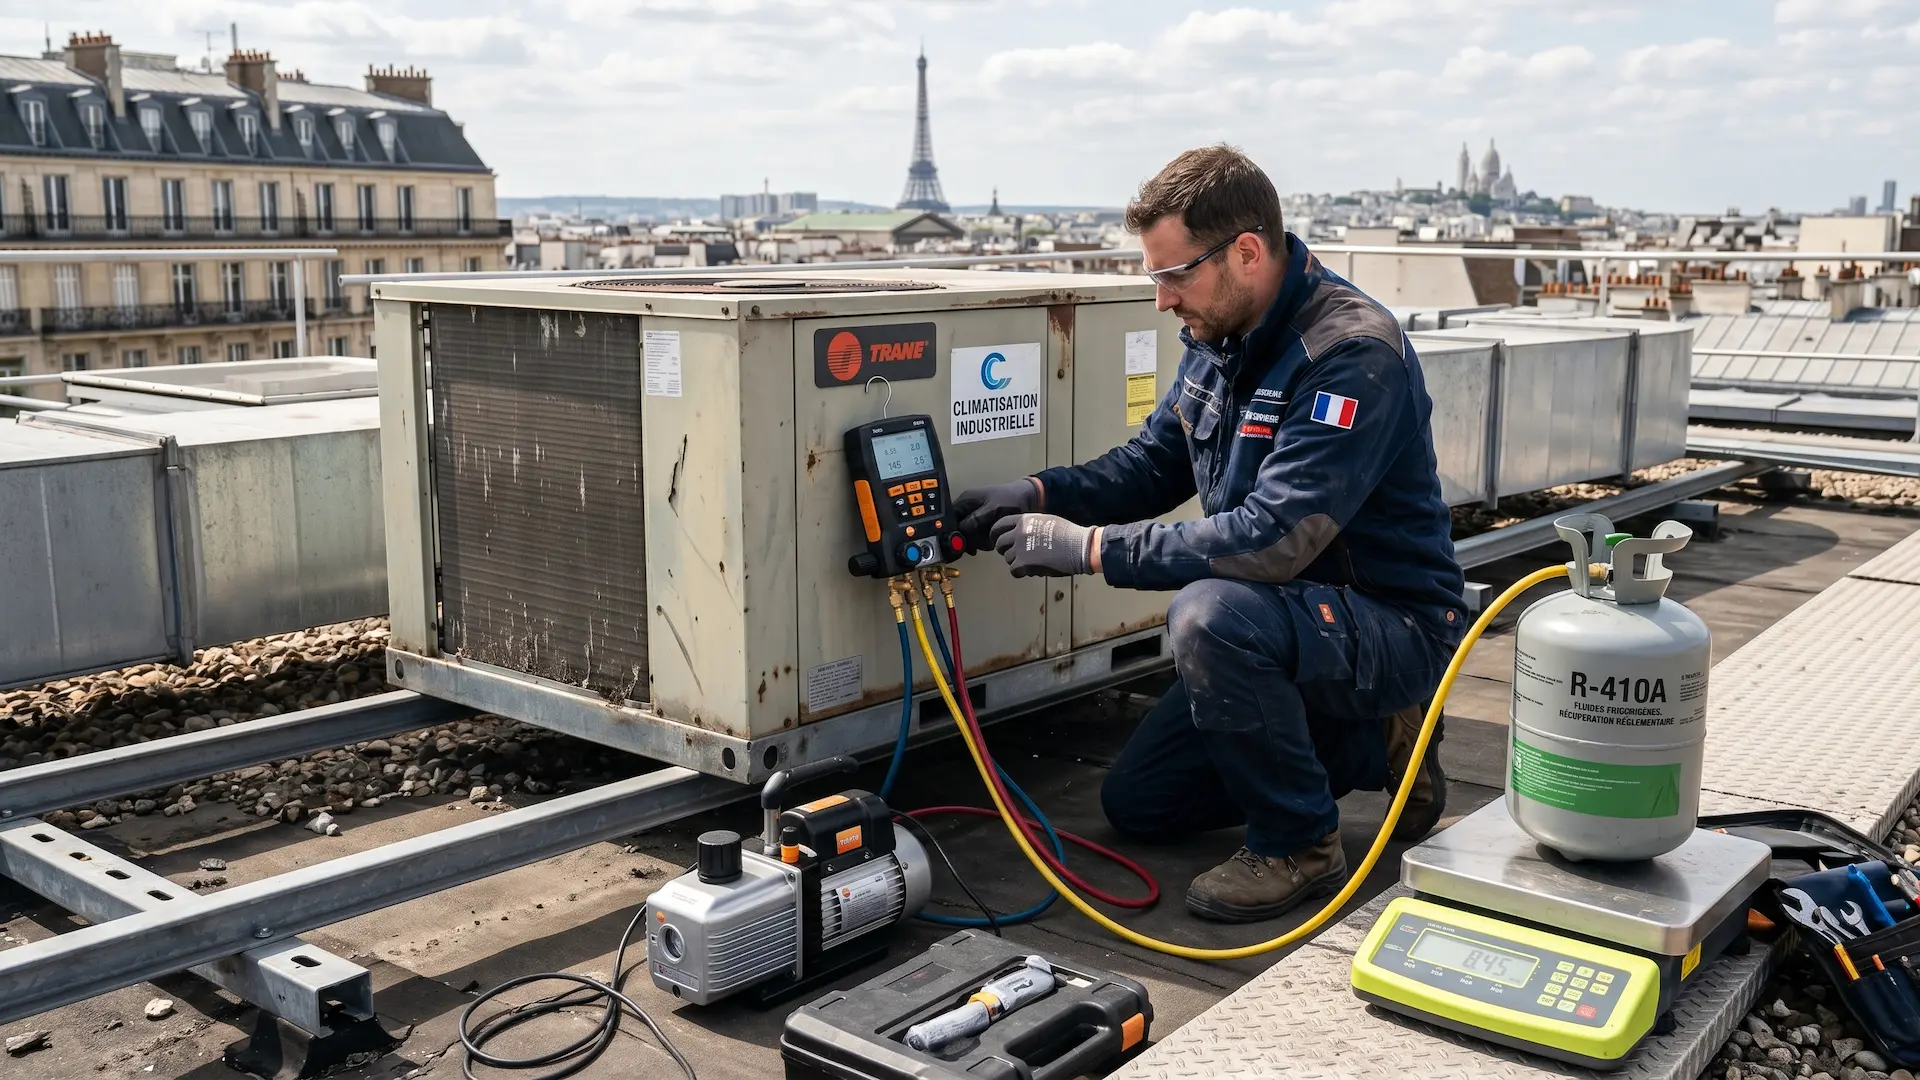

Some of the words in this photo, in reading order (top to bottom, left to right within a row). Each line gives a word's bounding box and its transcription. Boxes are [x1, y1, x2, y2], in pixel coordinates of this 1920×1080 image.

[870, 341, 925, 362] TRANE
[953, 393, 1038, 416] CLIMATISATION
[956, 413, 1035, 436] INDUSTRIELLE
[1570, 671, 1667, 703] R-410A
[1574, 701, 1605, 713] FLUIDES
